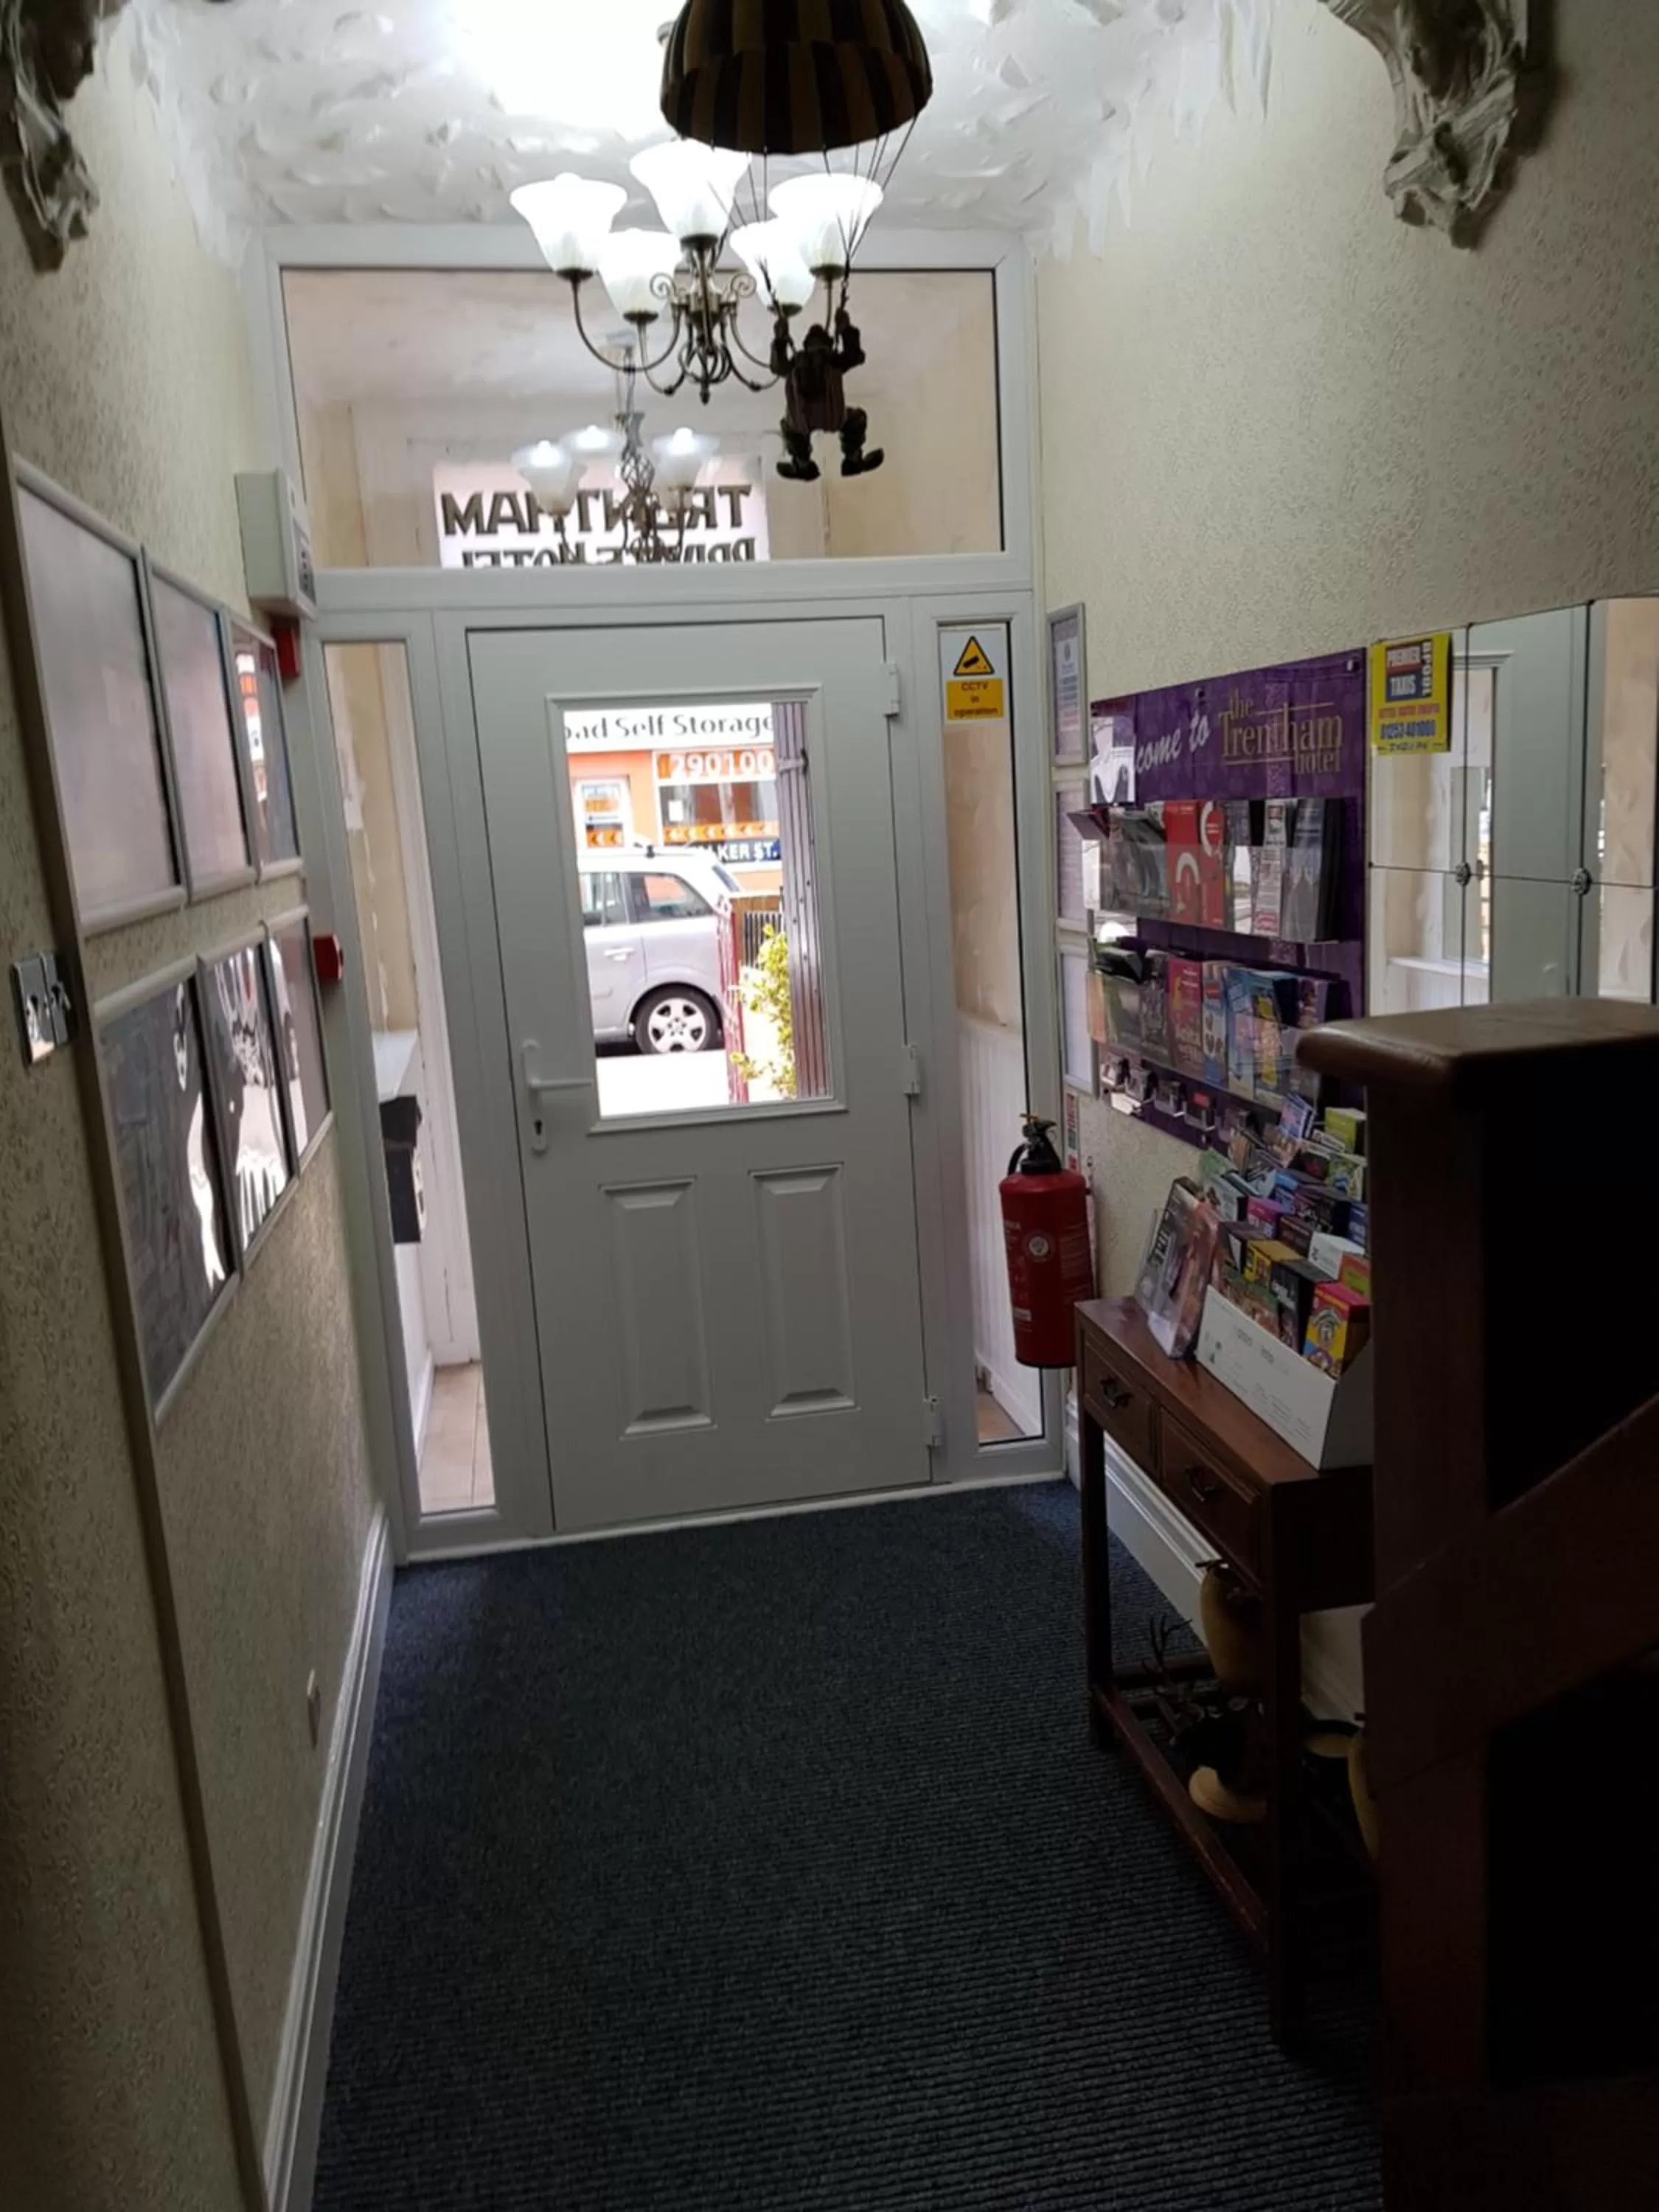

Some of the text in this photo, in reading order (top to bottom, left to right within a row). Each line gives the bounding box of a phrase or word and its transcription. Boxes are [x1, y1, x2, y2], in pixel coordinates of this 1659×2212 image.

[1229, 687, 1253, 720] the
[615, 714, 664, 737] Self
[1189, 709, 1211, 753] to
[1218, 702, 1343, 757] Trentham
[1294, 746, 1341, 775] hotel
